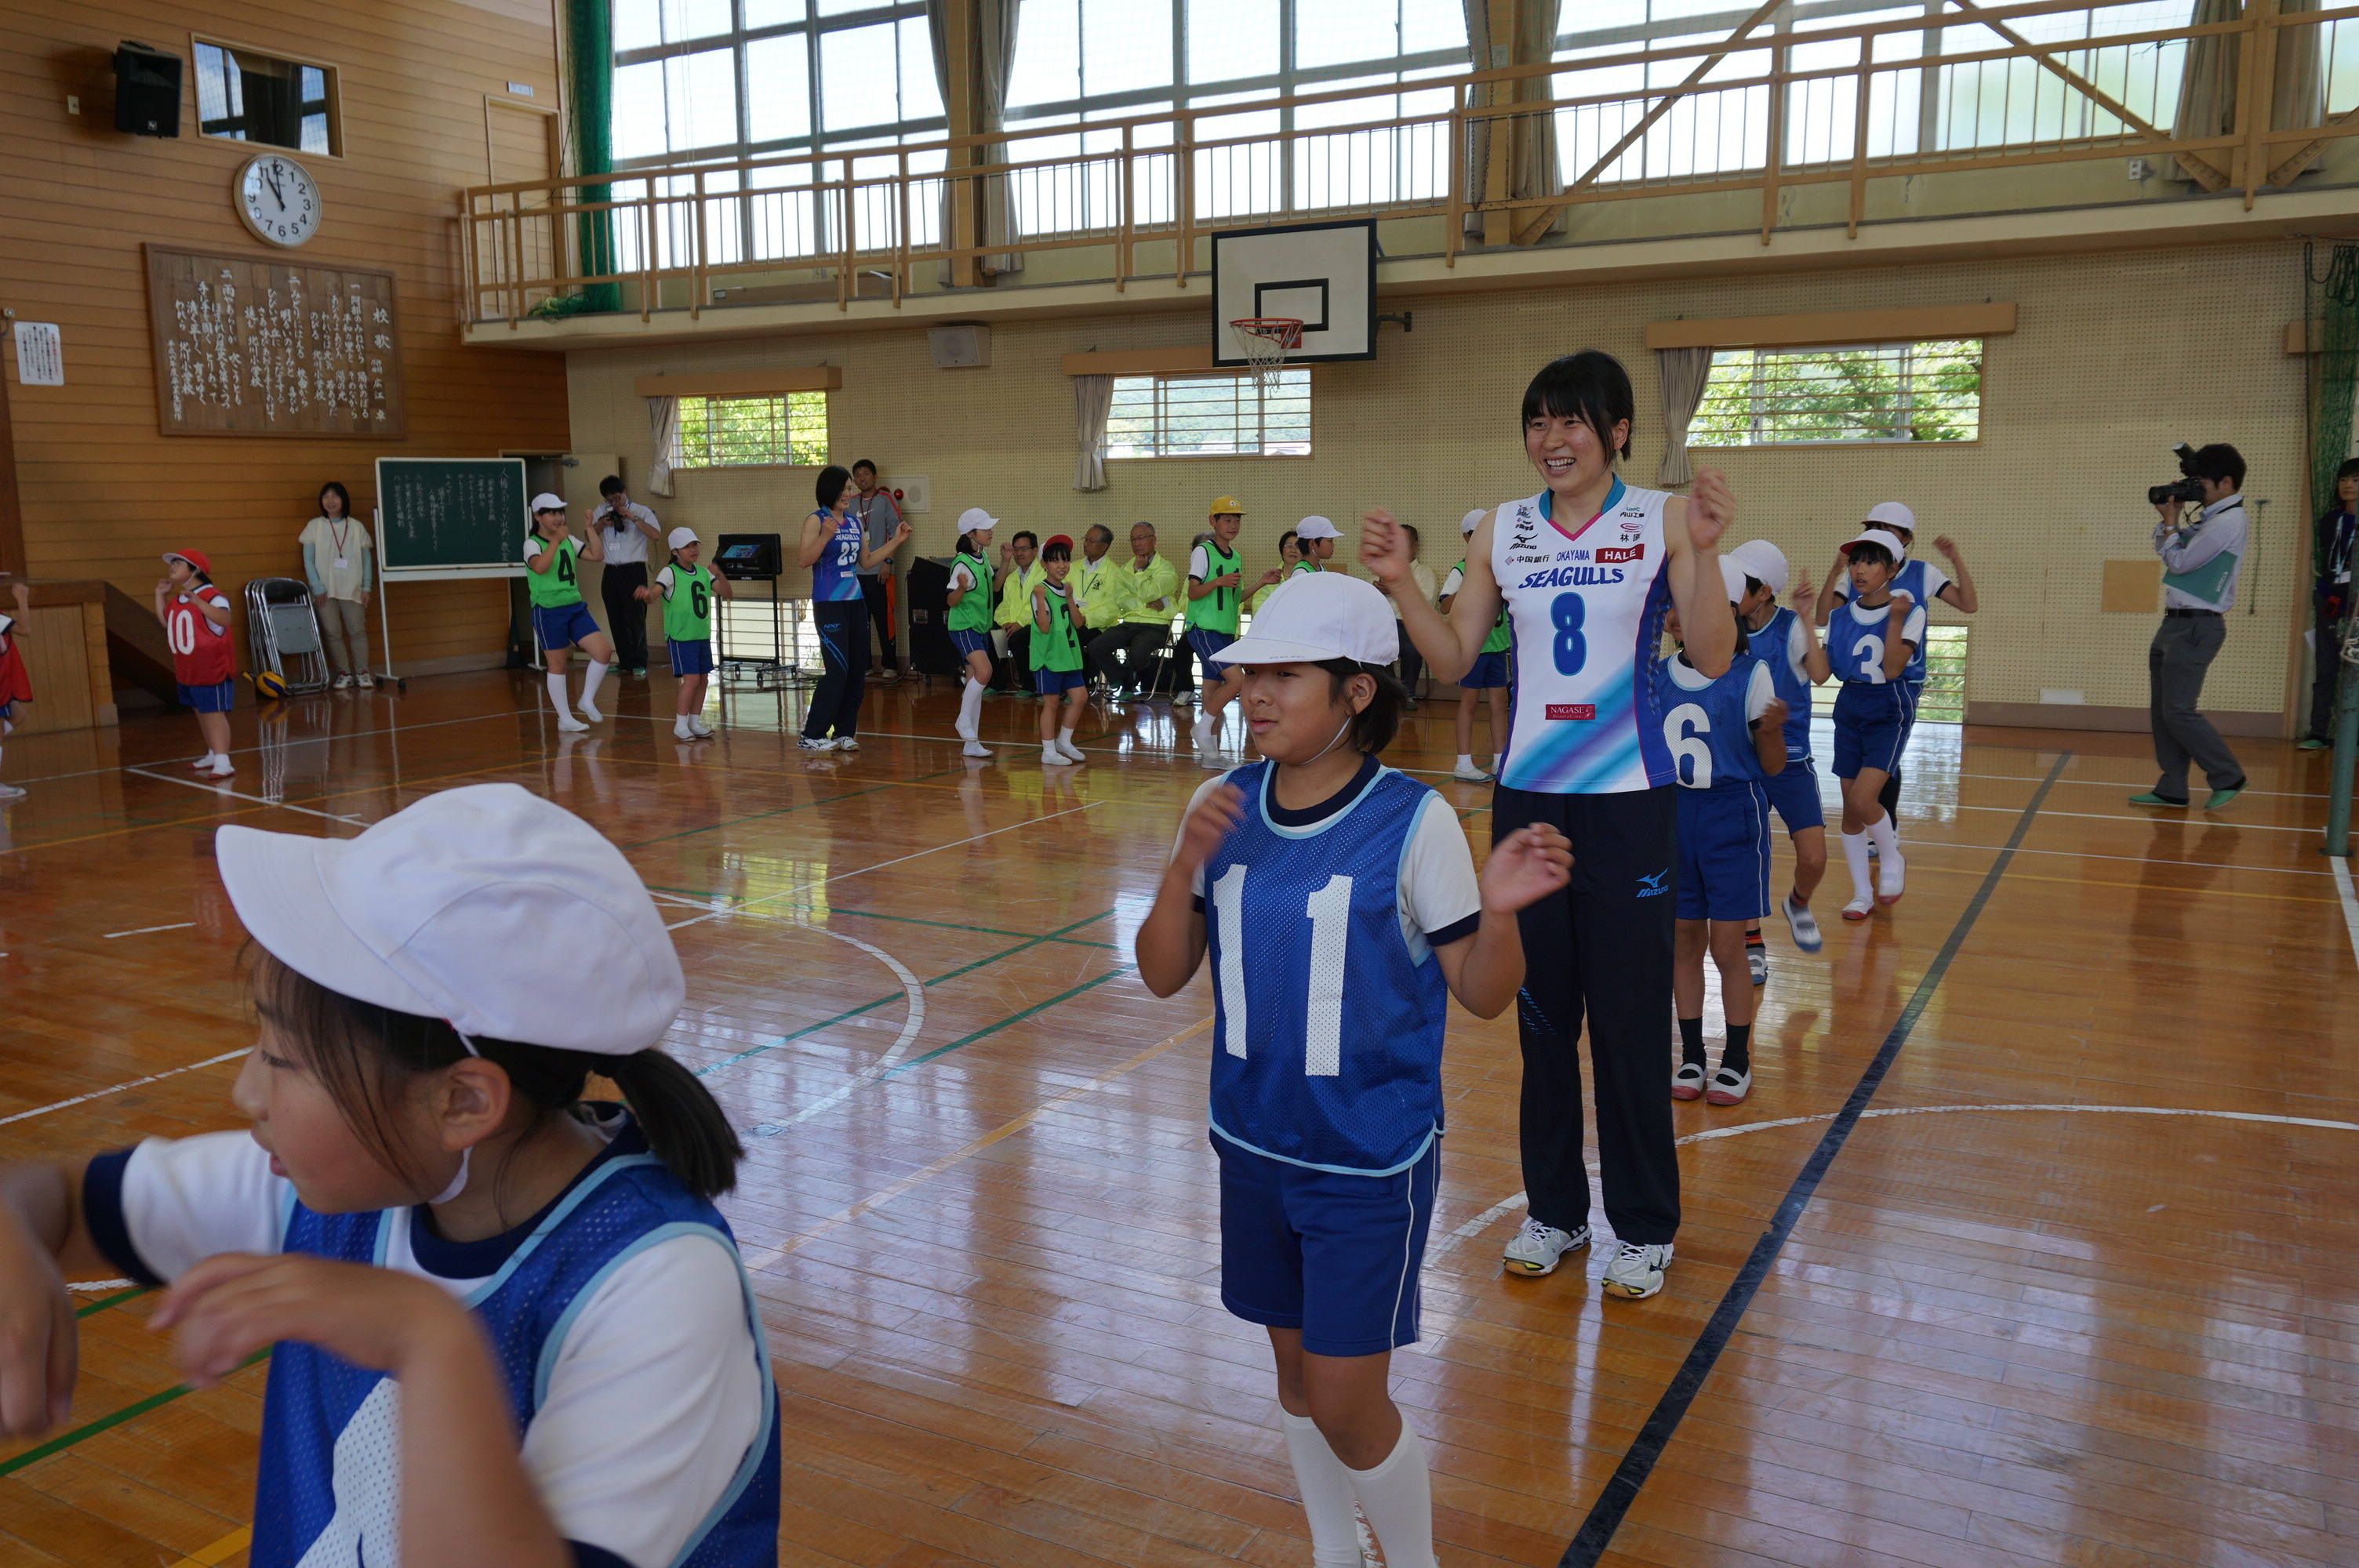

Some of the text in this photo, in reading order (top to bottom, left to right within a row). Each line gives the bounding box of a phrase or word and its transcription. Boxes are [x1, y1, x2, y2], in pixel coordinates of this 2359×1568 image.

[289, 170, 295, 183] 1
[298, 183, 307, 195] 2
[253, 207, 262, 220] 8
[304, 198, 311, 211] 3
[265, 220, 274, 230] 7
[291, 223, 299, 234] 5
[299, 213, 307, 225] 4
[278, 225, 286, 237] 6
[247, 335, 264, 387] 北川小学校
[313, 350, 326, 401] 北川小学校
[837, 541, 860, 566] 23
[1516, 554, 1550, 564] 中国銀行
[1556, 550, 1590, 562] OKAYAMA
[1605, 548, 1636, 561] HALE
[558, 549, 575, 586] 4
[1518, 566, 1624, 589] SEAGULLS
[690, 580, 709, 619] 6
[983, 568, 990, 610] 1
[167, 608, 195, 655] 10
[1060, 603, 1076, 648] 2
[1550, 591, 1587, 677] 8
[1852, 633, 1886, 684] 3
[1663, 702, 1713, 789] 6
[1636, 885, 1669, 898] MIZUNO
[1212, 863, 1354, 1076] 11
